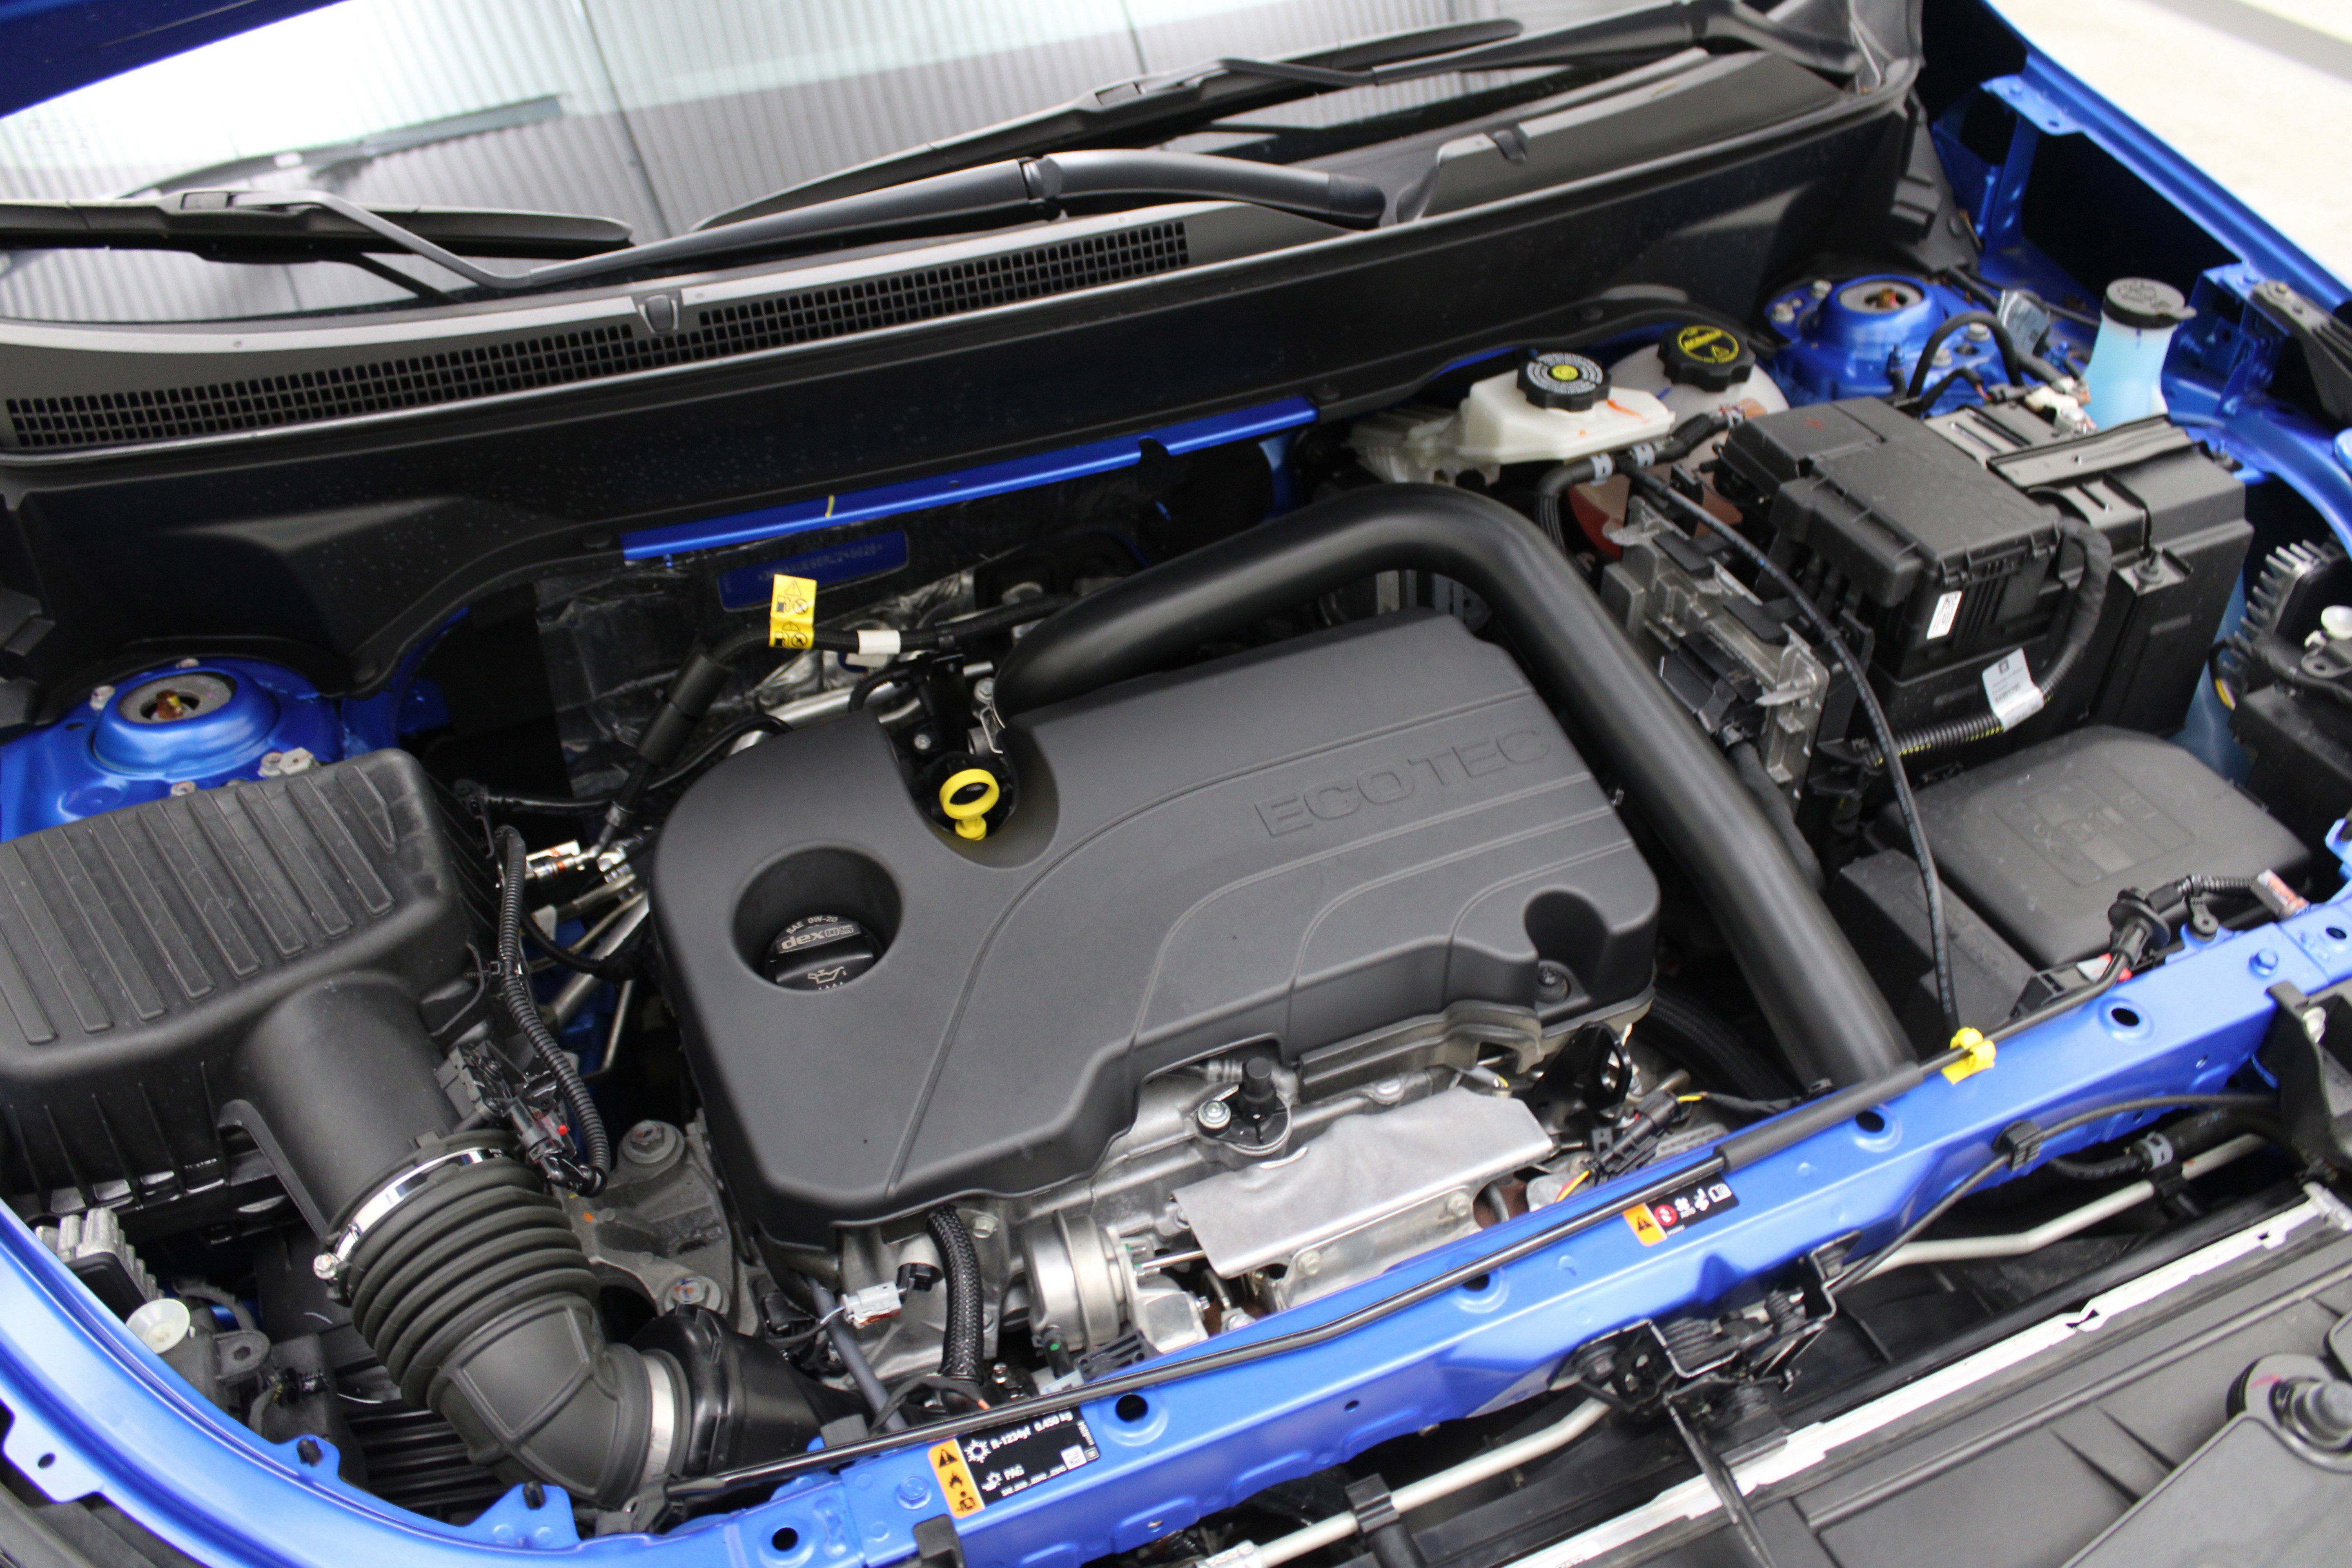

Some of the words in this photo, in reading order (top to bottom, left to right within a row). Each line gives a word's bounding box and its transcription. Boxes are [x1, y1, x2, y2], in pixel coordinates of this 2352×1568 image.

[1254, 729, 1551, 837] ECOTEC
[786, 922, 804, 934] SAE
[807, 915, 838, 924] 0W-20
[781, 925, 855, 950] dexos
[991, 1425, 1031, 1450] R-1234yf
[1003, 1465, 1025, 1481] PAG
